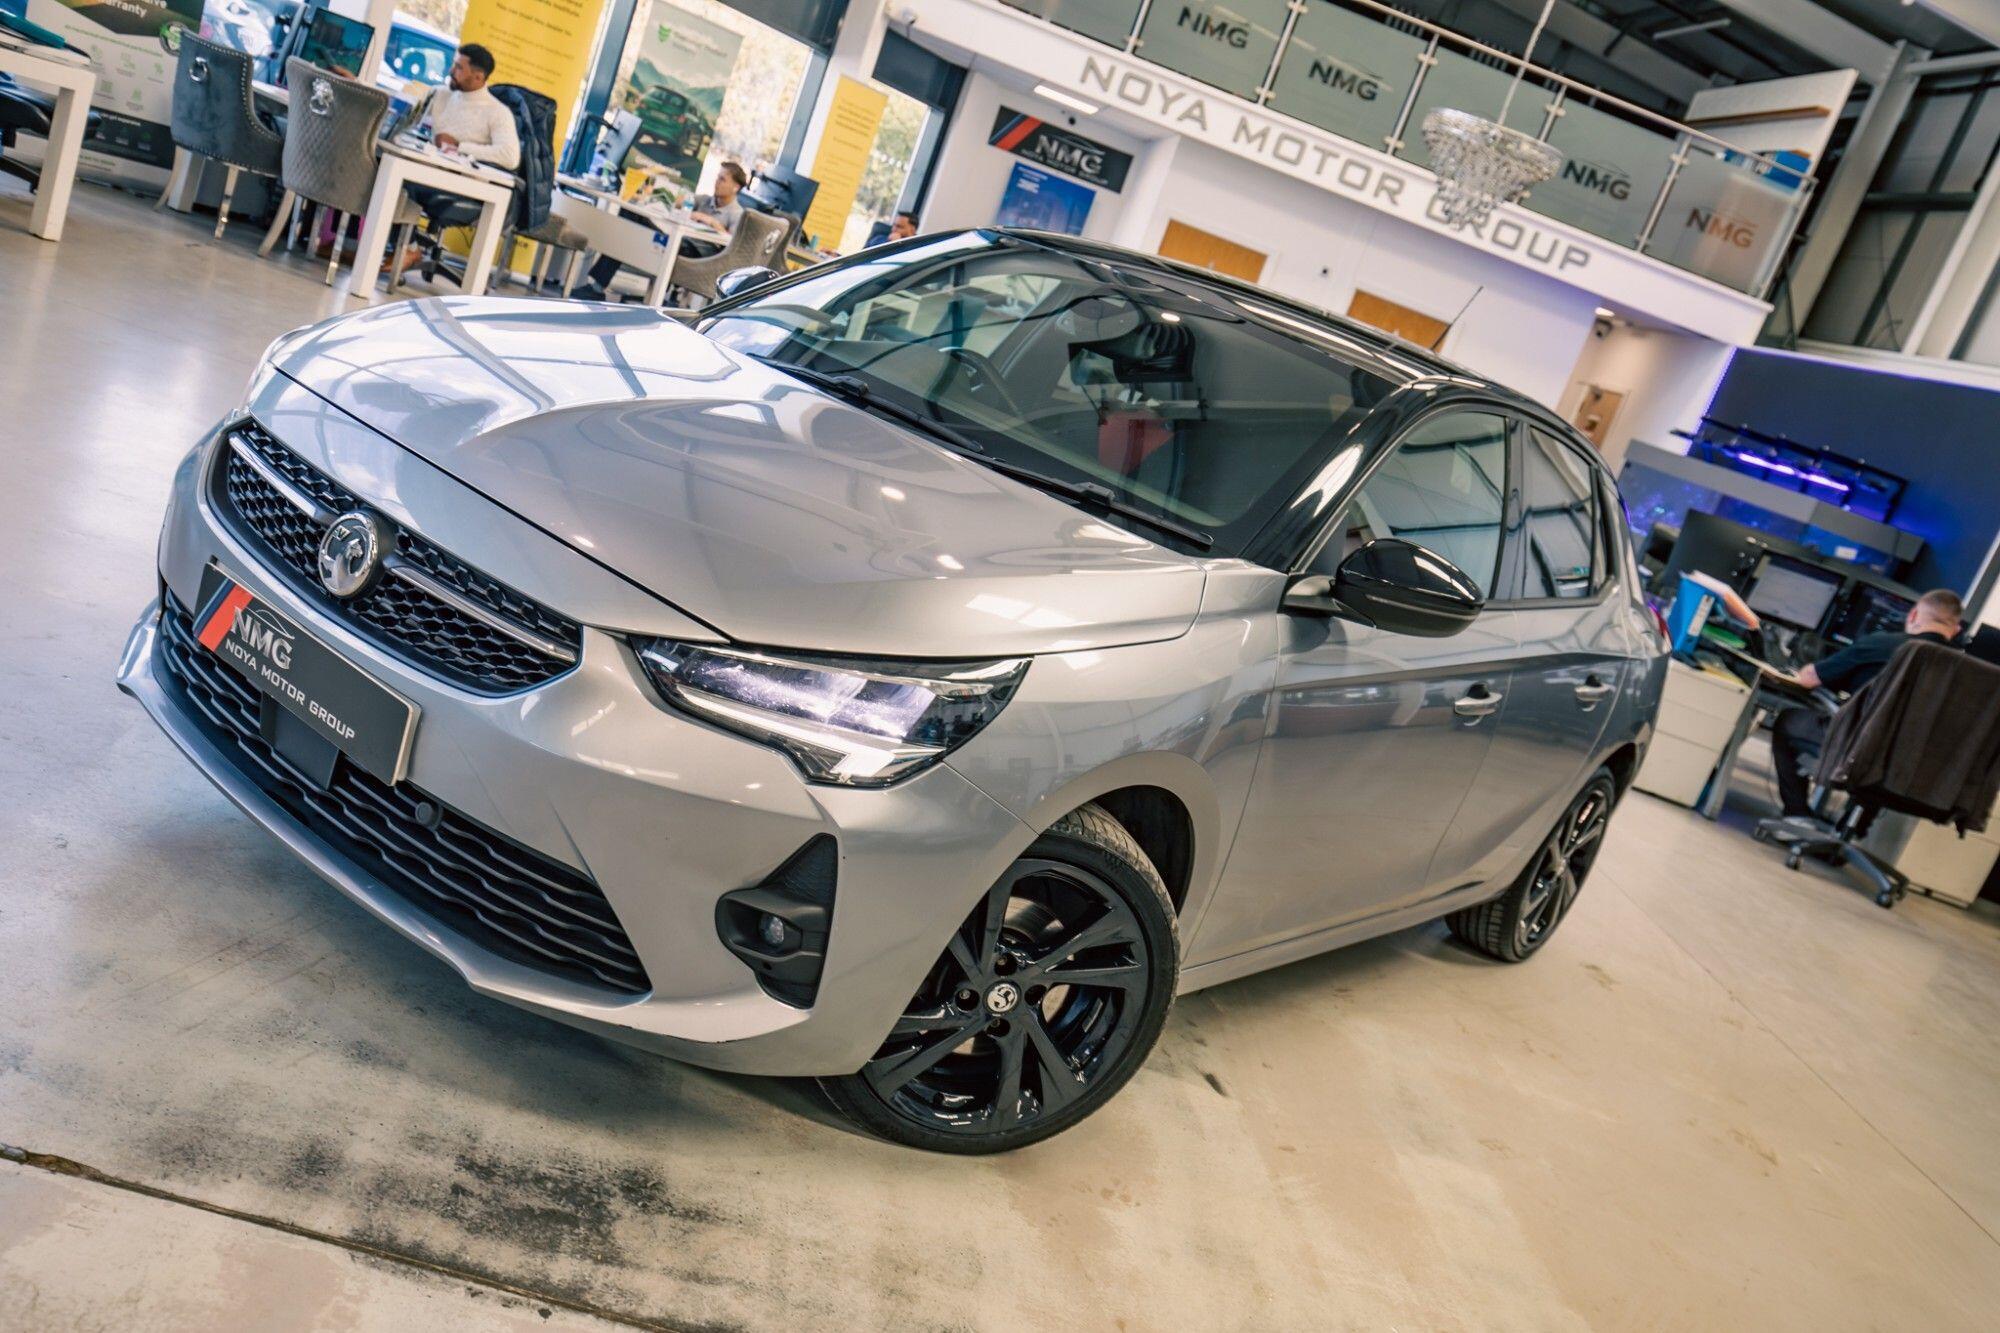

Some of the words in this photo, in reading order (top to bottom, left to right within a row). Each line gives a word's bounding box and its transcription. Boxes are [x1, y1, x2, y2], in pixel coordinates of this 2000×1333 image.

[1177, 6, 1249, 49] NMG
[1308, 60, 1379, 101] NMG
[1080, 56, 1208, 131] NOYA
[1232, 116, 1406, 206] MOTOR
[1035, 134, 1103, 174] NMG
[1562, 159, 1632, 200] NMG
[1685, 207, 1755, 248] NMG
[230, 606, 293, 670] NMG
[225, 638, 257, 671] NOYA
[261, 664, 306, 706] MOTOR
[309, 700, 355, 739] GROUP
